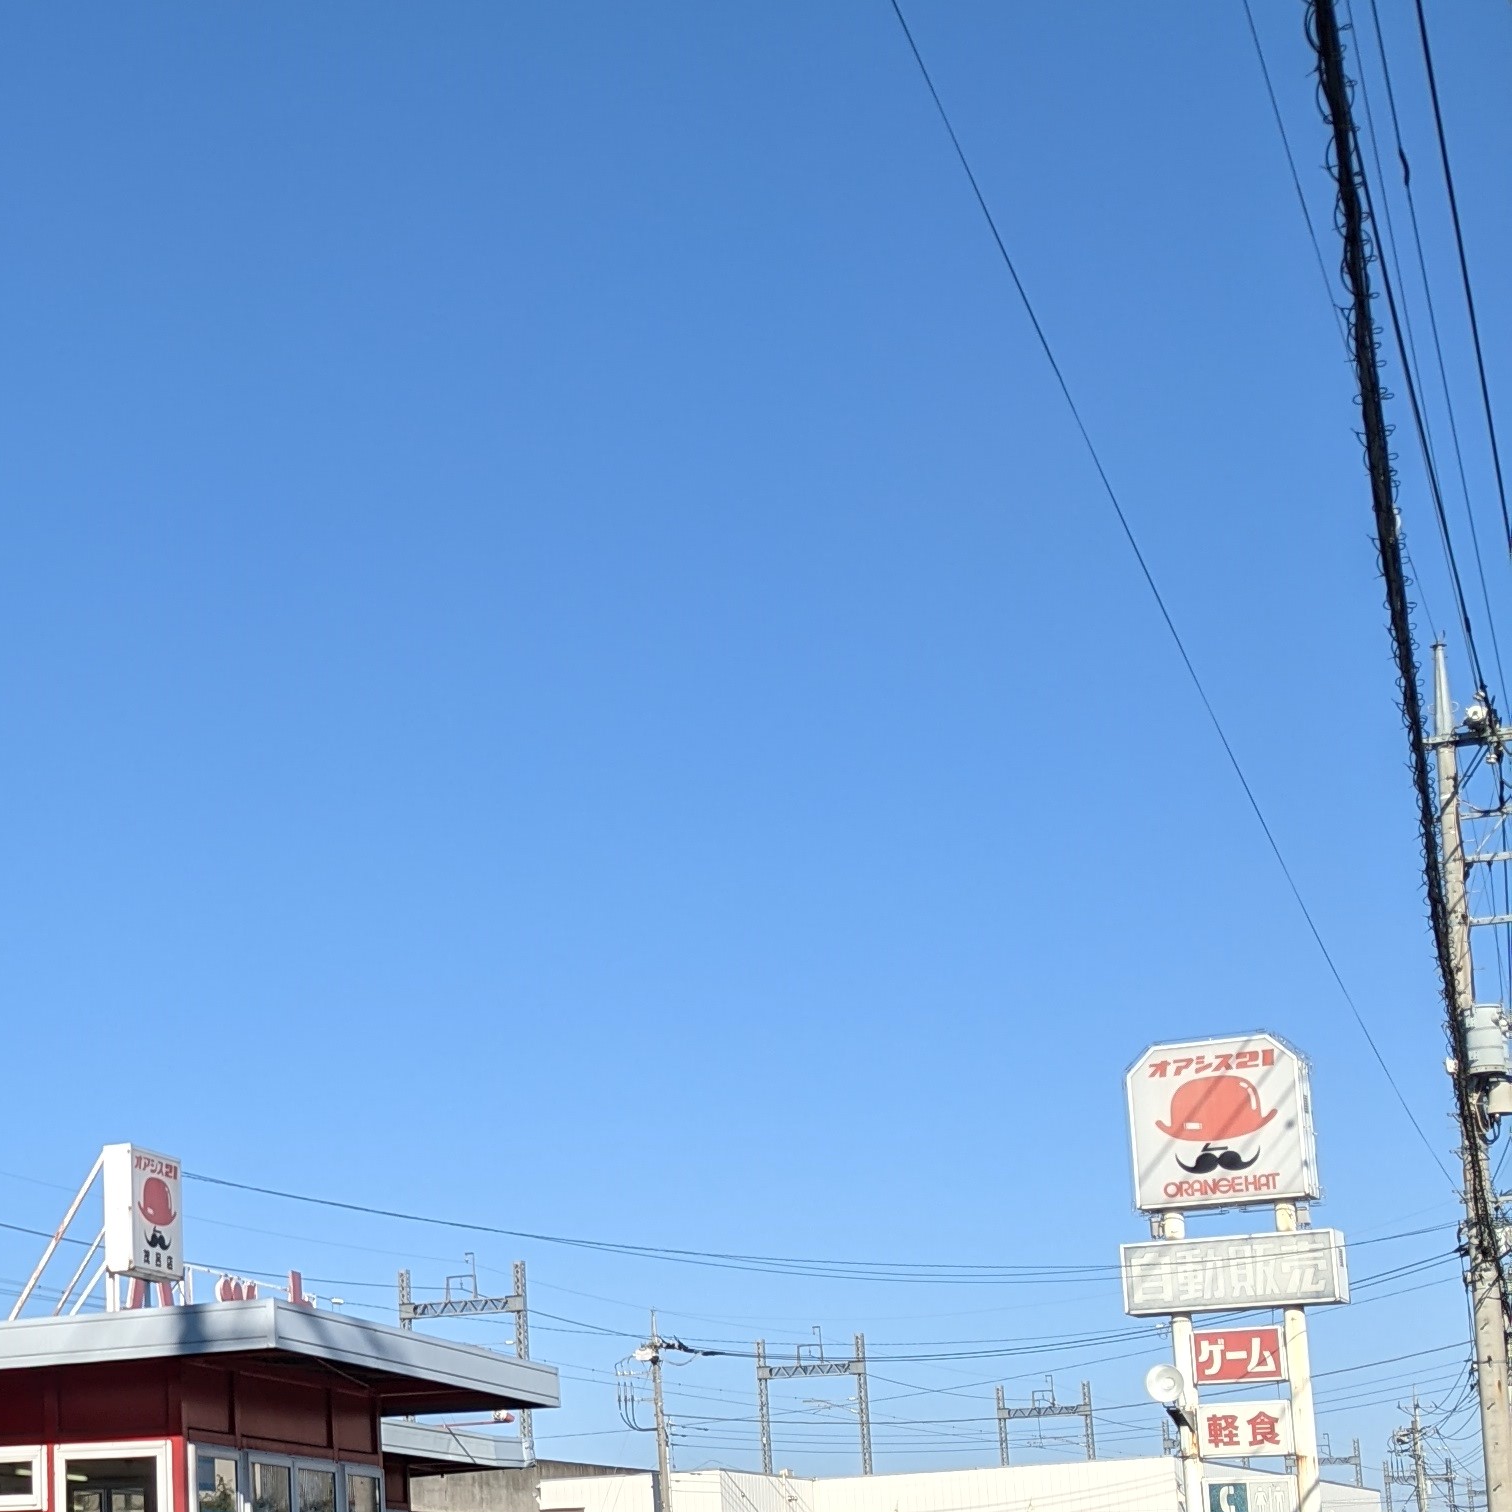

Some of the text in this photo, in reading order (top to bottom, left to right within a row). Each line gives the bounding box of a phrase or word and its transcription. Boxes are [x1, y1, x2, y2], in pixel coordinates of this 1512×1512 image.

[1148, 1048, 1275, 1078] オアシス21
[134, 1155, 178, 1180] オアシス21
[1131, 1240, 1327, 1303] 自動販売
[1198, 1337, 1277, 1376] ゲーム
[1207, 1411, 1281, 1448] 軽食
